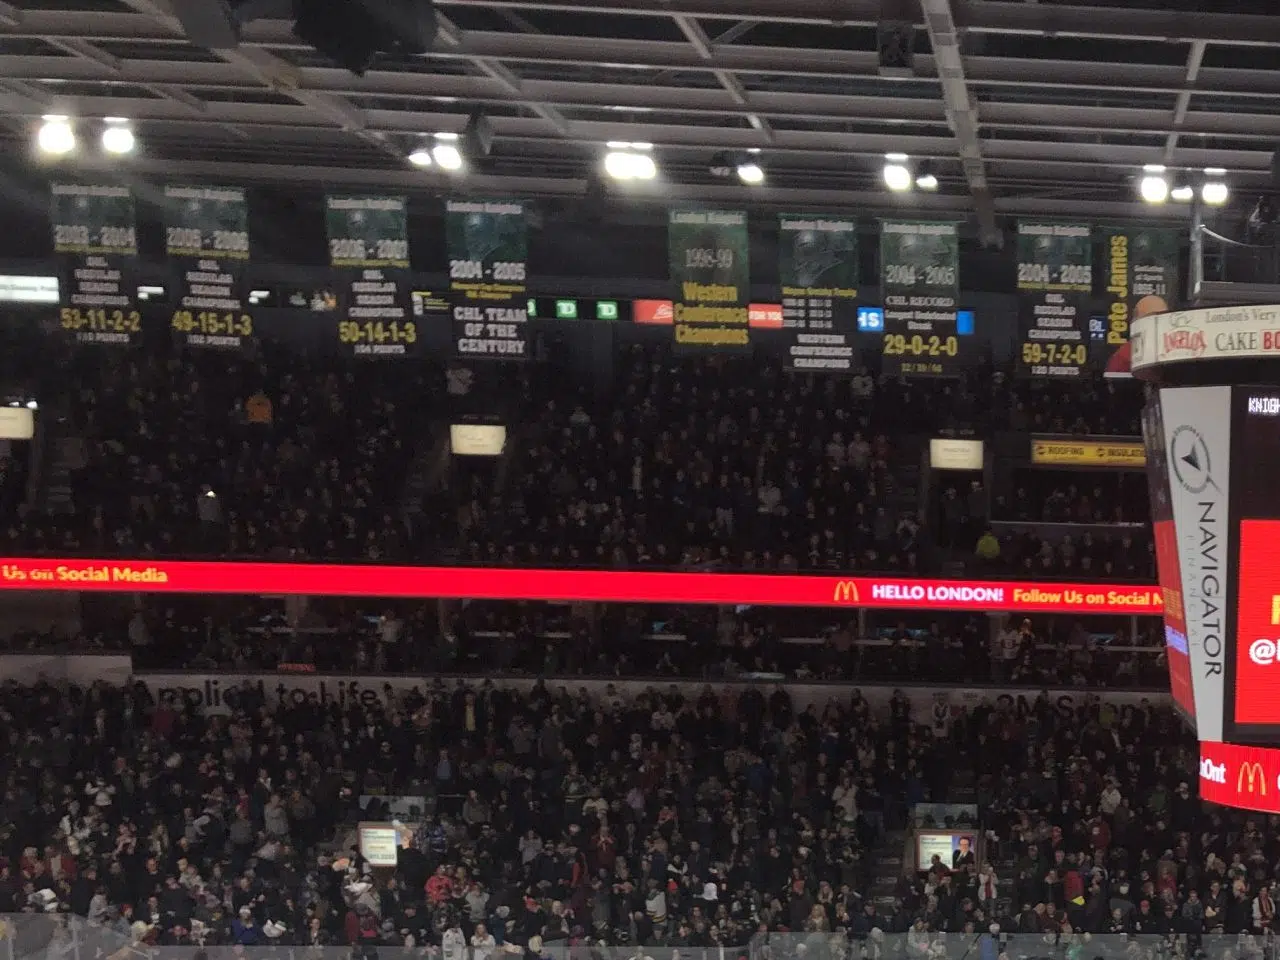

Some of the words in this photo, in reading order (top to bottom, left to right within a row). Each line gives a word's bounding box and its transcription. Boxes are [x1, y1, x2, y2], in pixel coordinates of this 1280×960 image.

[1107, 235, 1128, 297] James
[60, 308, 141, 332] 53-11-2-2
[454, 307, 483, 321] CHL
[486, 308, 527, 322] TEAM
[1107, 303, 1128, 344] Pete
[1205, 310, 1249, 324] London's
[1251, 308, 1277, 323] Very
[465, 324, 484, 336] OF
[487, 324, 517, 337] THE
[458, 339, 525, 353] CENTURY
[884, 334, 957, 356] 29-0-2-0
[1215, 332, 1257, 351] CAKE
[1023, 343, 1086, 364] 59-7-2-0
[2, 565, 26, 580] Us
[57, 566, 109, 581] Social
[113, 568, 168, 582] Media
[872, 584, 925, 600] HELLO
[927, 586, 1004, 602] LONDON!
[1013, 588, 1062, 605] Follow
[1064, 590, 1083, 605] Us
[1086, 594, 1105, 605] on
[1107, 590, 1150, 606] Social
[1198, 501, 1223, 679] NAVIGATOR
